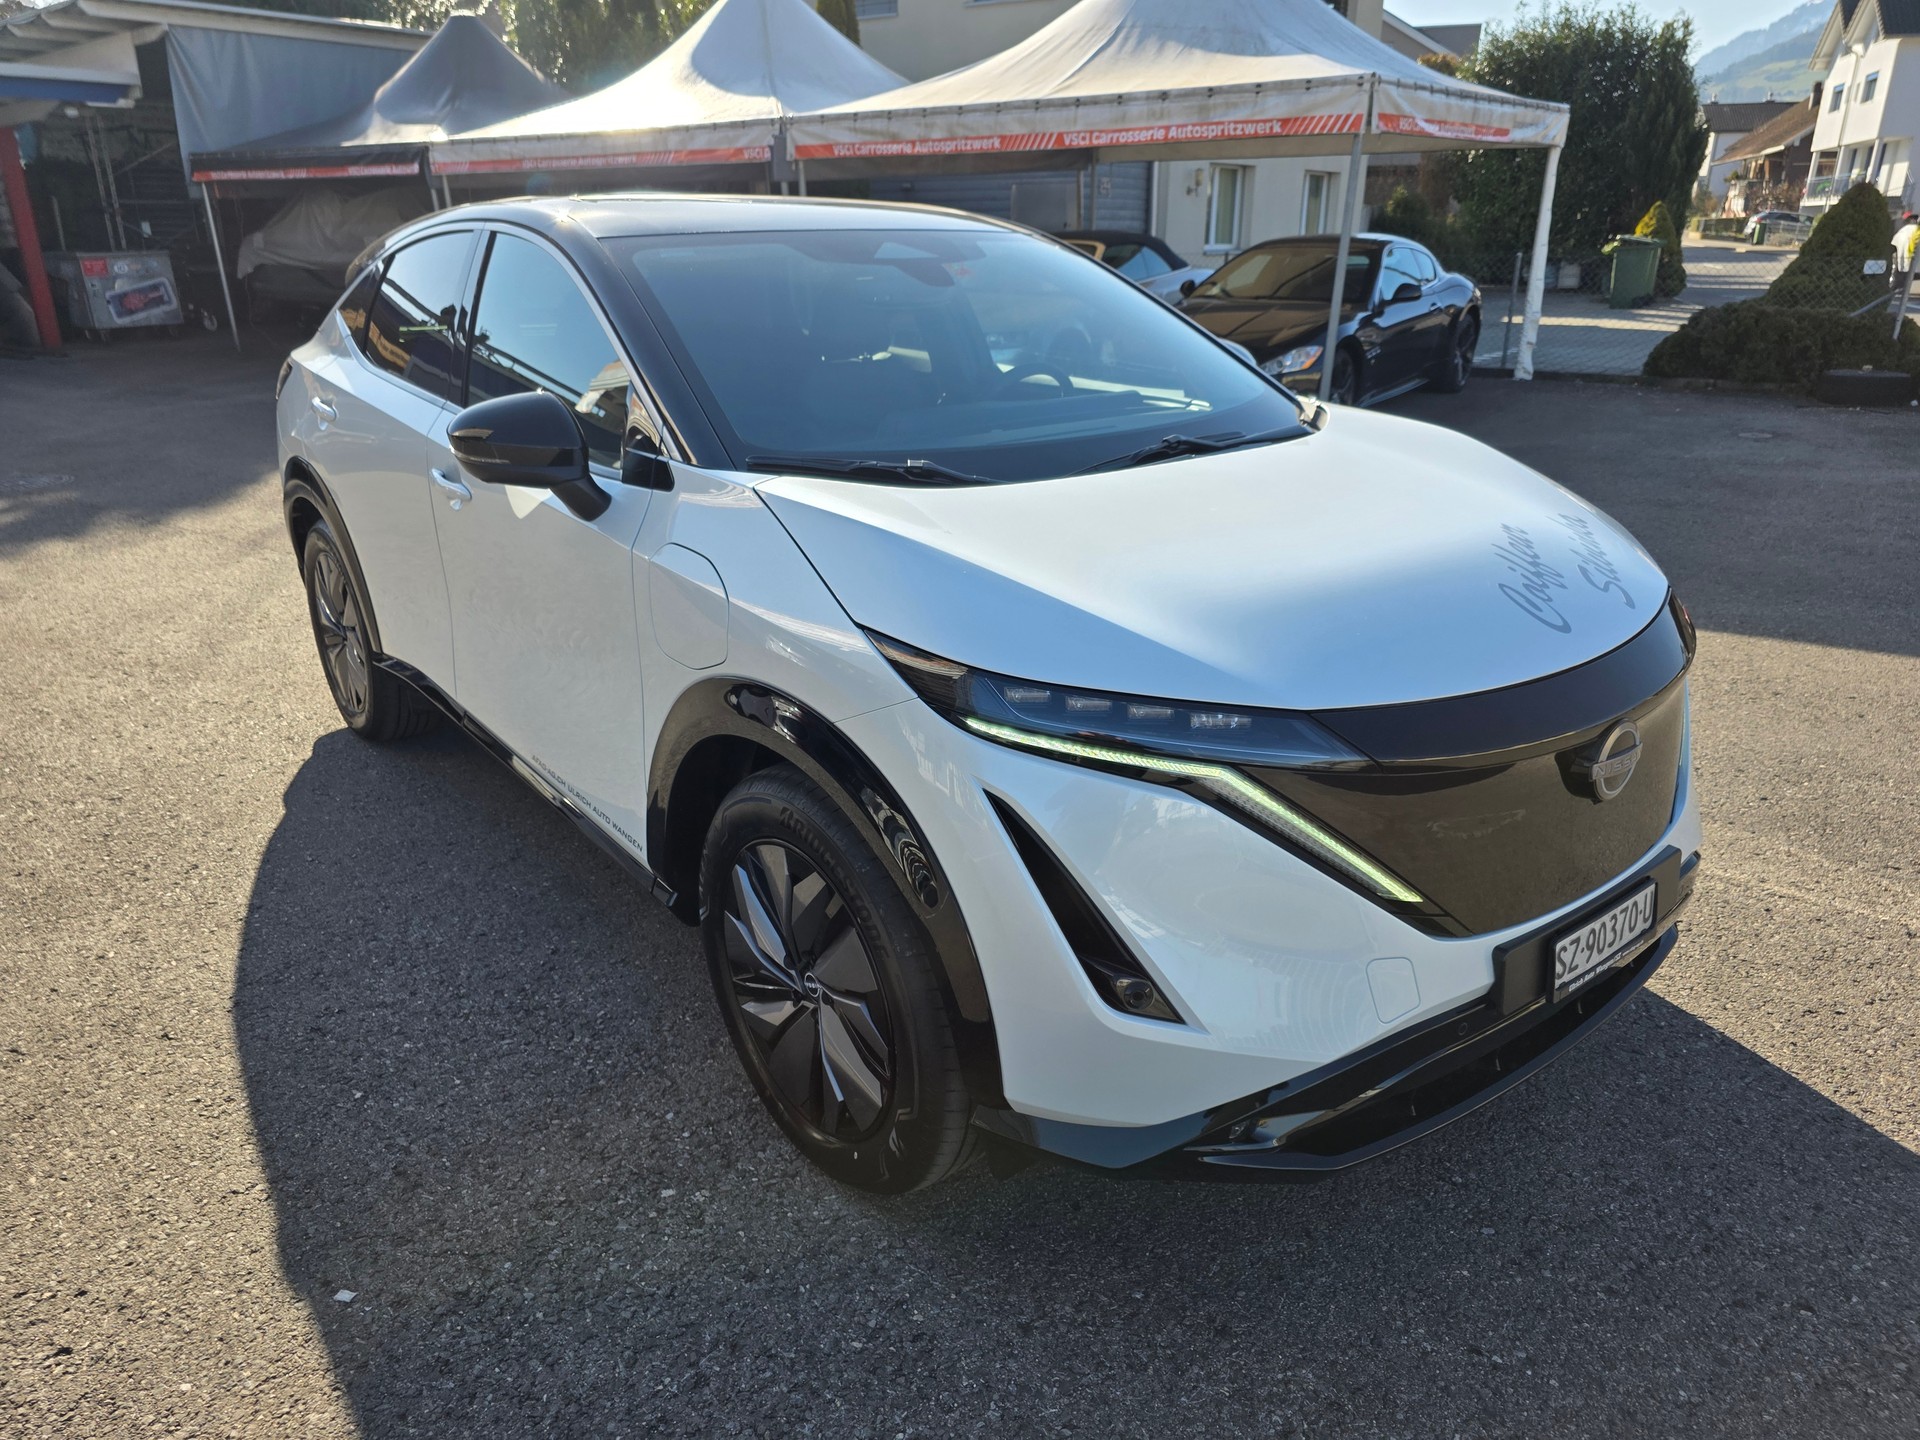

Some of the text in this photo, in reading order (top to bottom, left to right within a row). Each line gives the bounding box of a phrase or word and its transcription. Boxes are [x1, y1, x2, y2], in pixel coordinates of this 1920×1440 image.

[855, 140, 912, 155] Carrosserie
[915, 137, 1000, 154] Autospritzwerk
[1063, 120, 1282, 146] VSCI Carrosserie Autospritzwerk
[568, 785, 592, 809] ULRICH
[592, 806, 611, 825] AUTO
[612, 820, 643, 852] WANGEN
